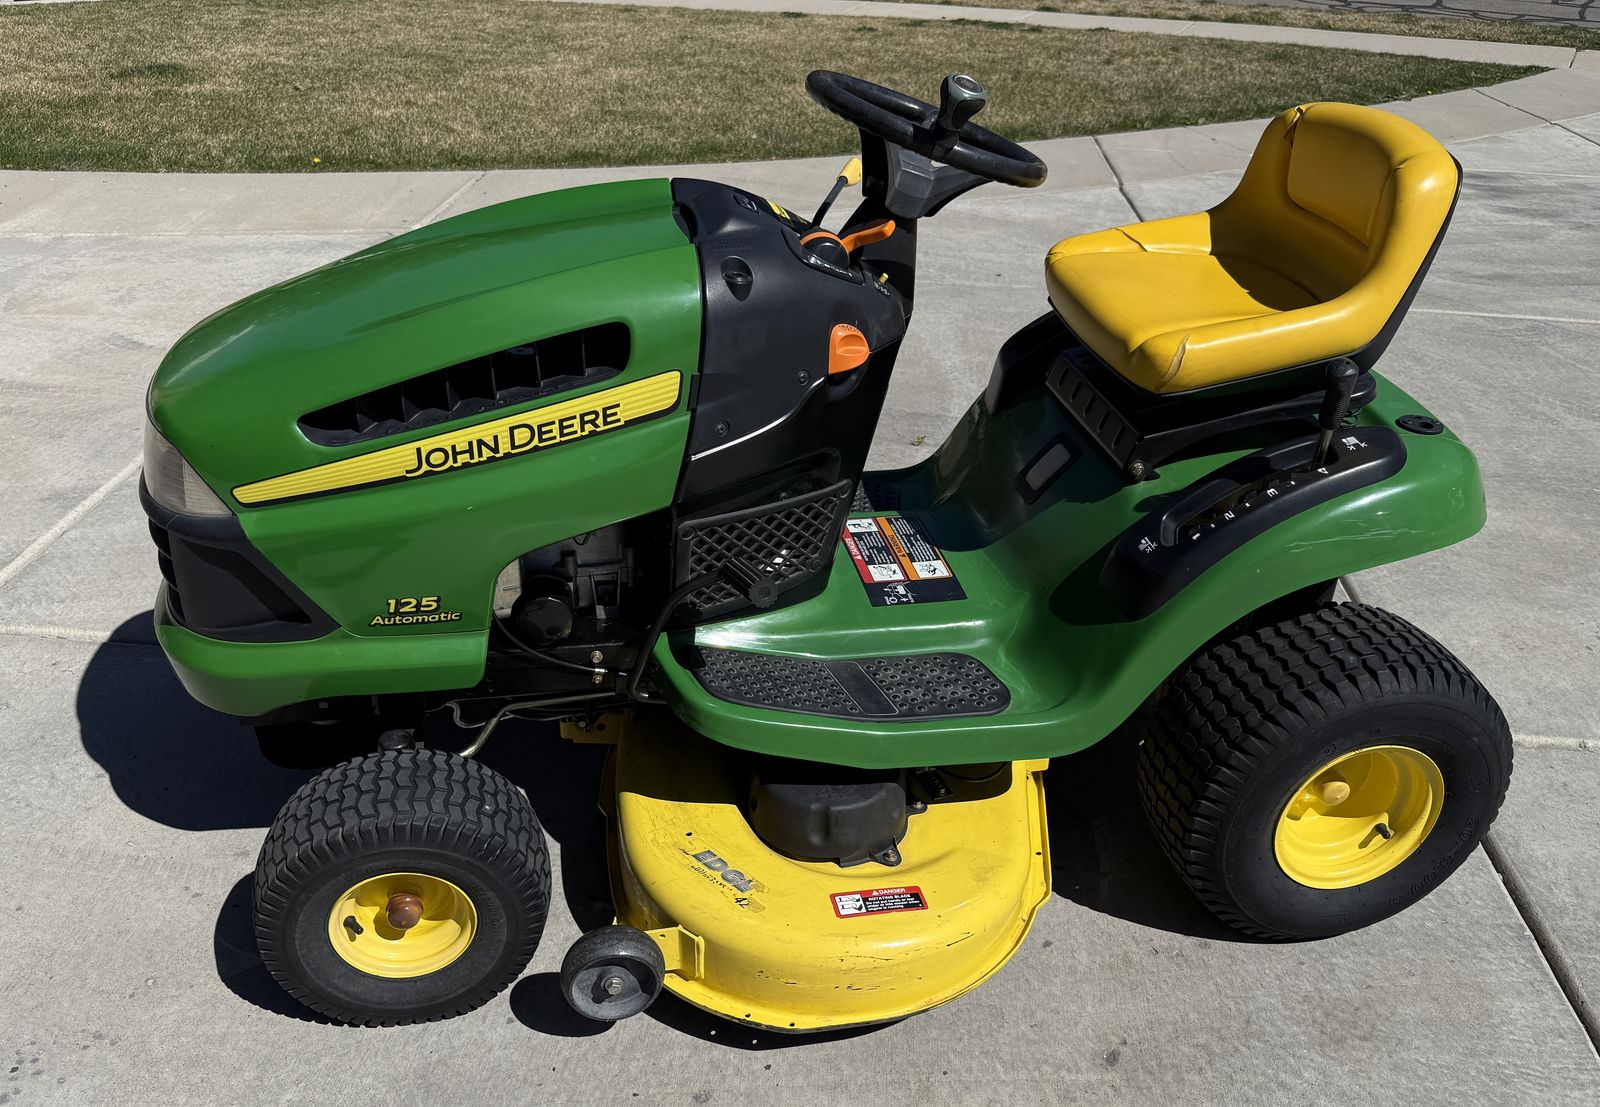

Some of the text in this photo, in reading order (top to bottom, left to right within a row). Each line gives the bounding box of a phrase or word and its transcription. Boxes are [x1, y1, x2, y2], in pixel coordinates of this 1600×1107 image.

[405, 403, 621, 474] JOHN DEERE
[387, 596, 438, 613] 125
[370, 611, 461, 626] Automatic
